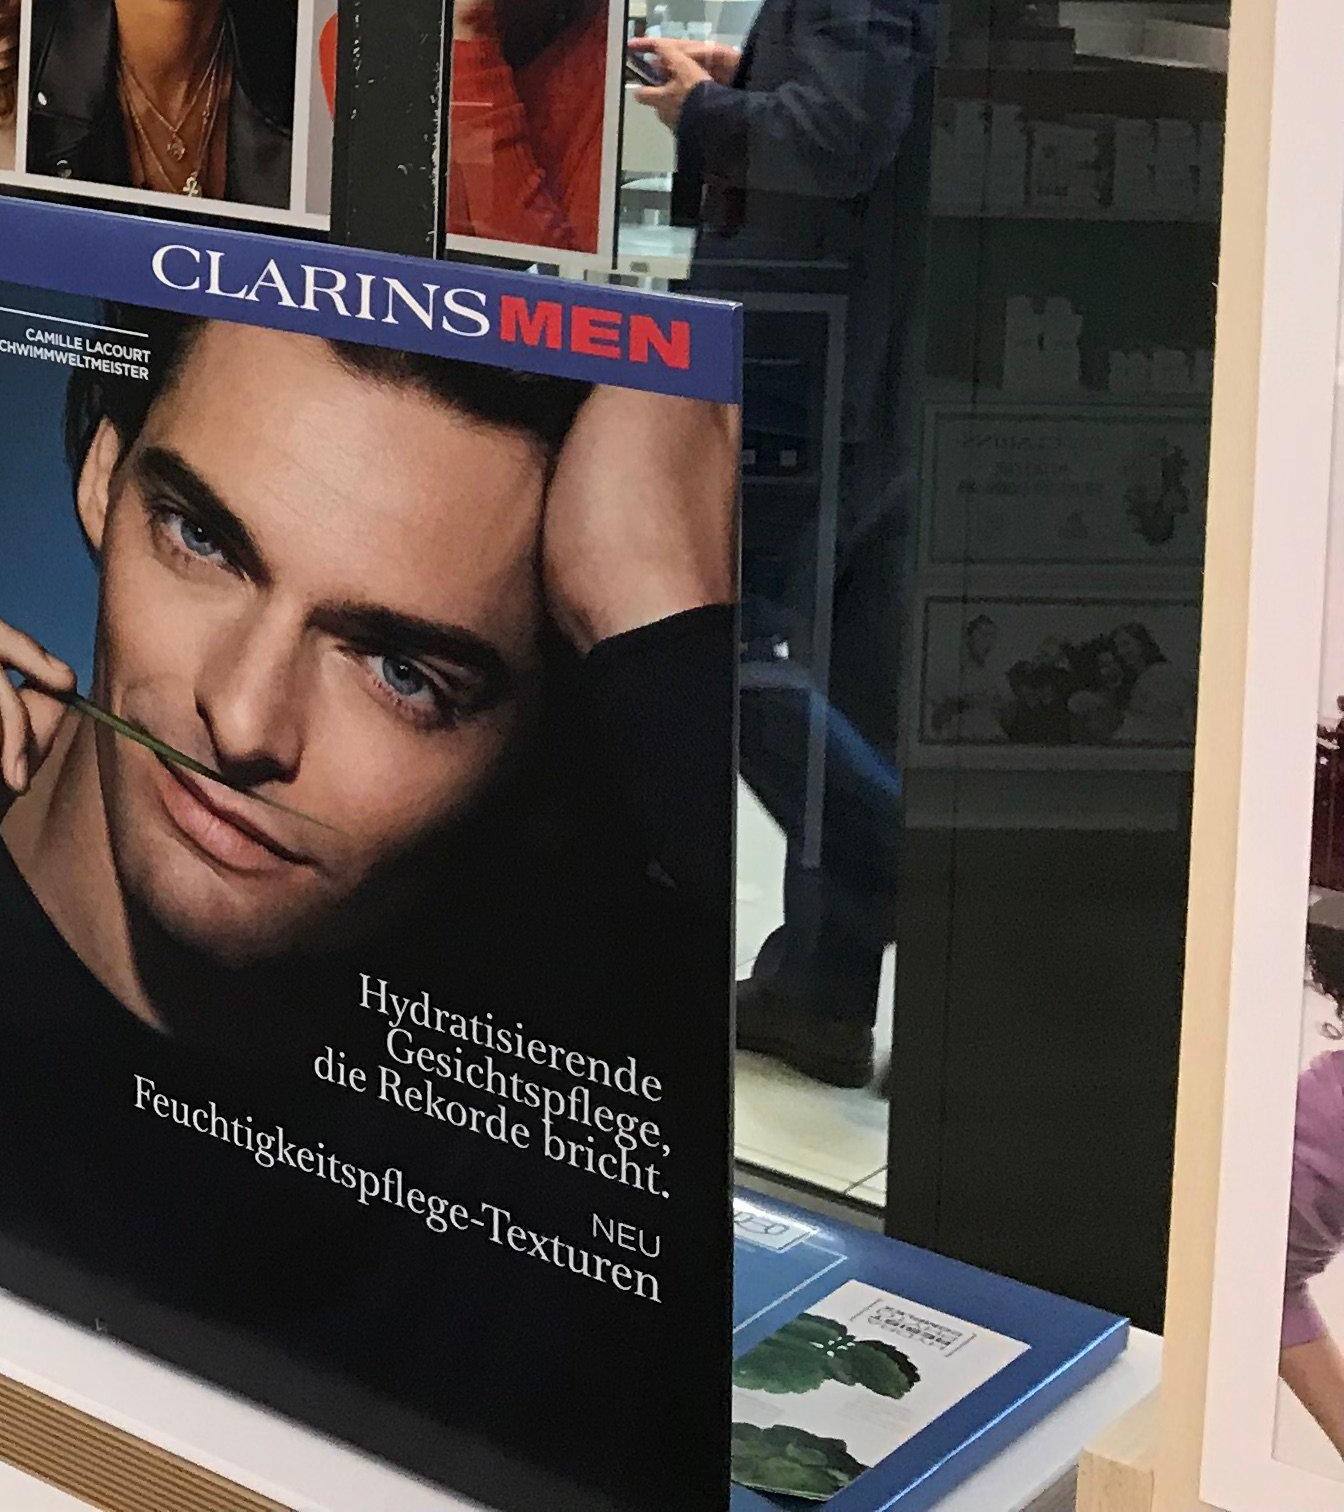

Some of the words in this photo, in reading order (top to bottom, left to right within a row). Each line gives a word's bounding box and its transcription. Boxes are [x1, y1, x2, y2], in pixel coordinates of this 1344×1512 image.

[25, 326, 82, 349] CAMILLE
[85, 335, 151, 363] LACOURT
[358, 973, 663, 1102] Hydratisierende
[387, 1029, 672, 1156] Gesichtspflege,
[314, 1046, 367, 1094] die
[377, 1066, 531, 1150] Rekorde
[544, 1120, 671, 1200] bricht.
[133, 1075, 663, 1304] Feuchtigkeitspflege-Texturen
[593, 1213, 662, 1259] NEU
